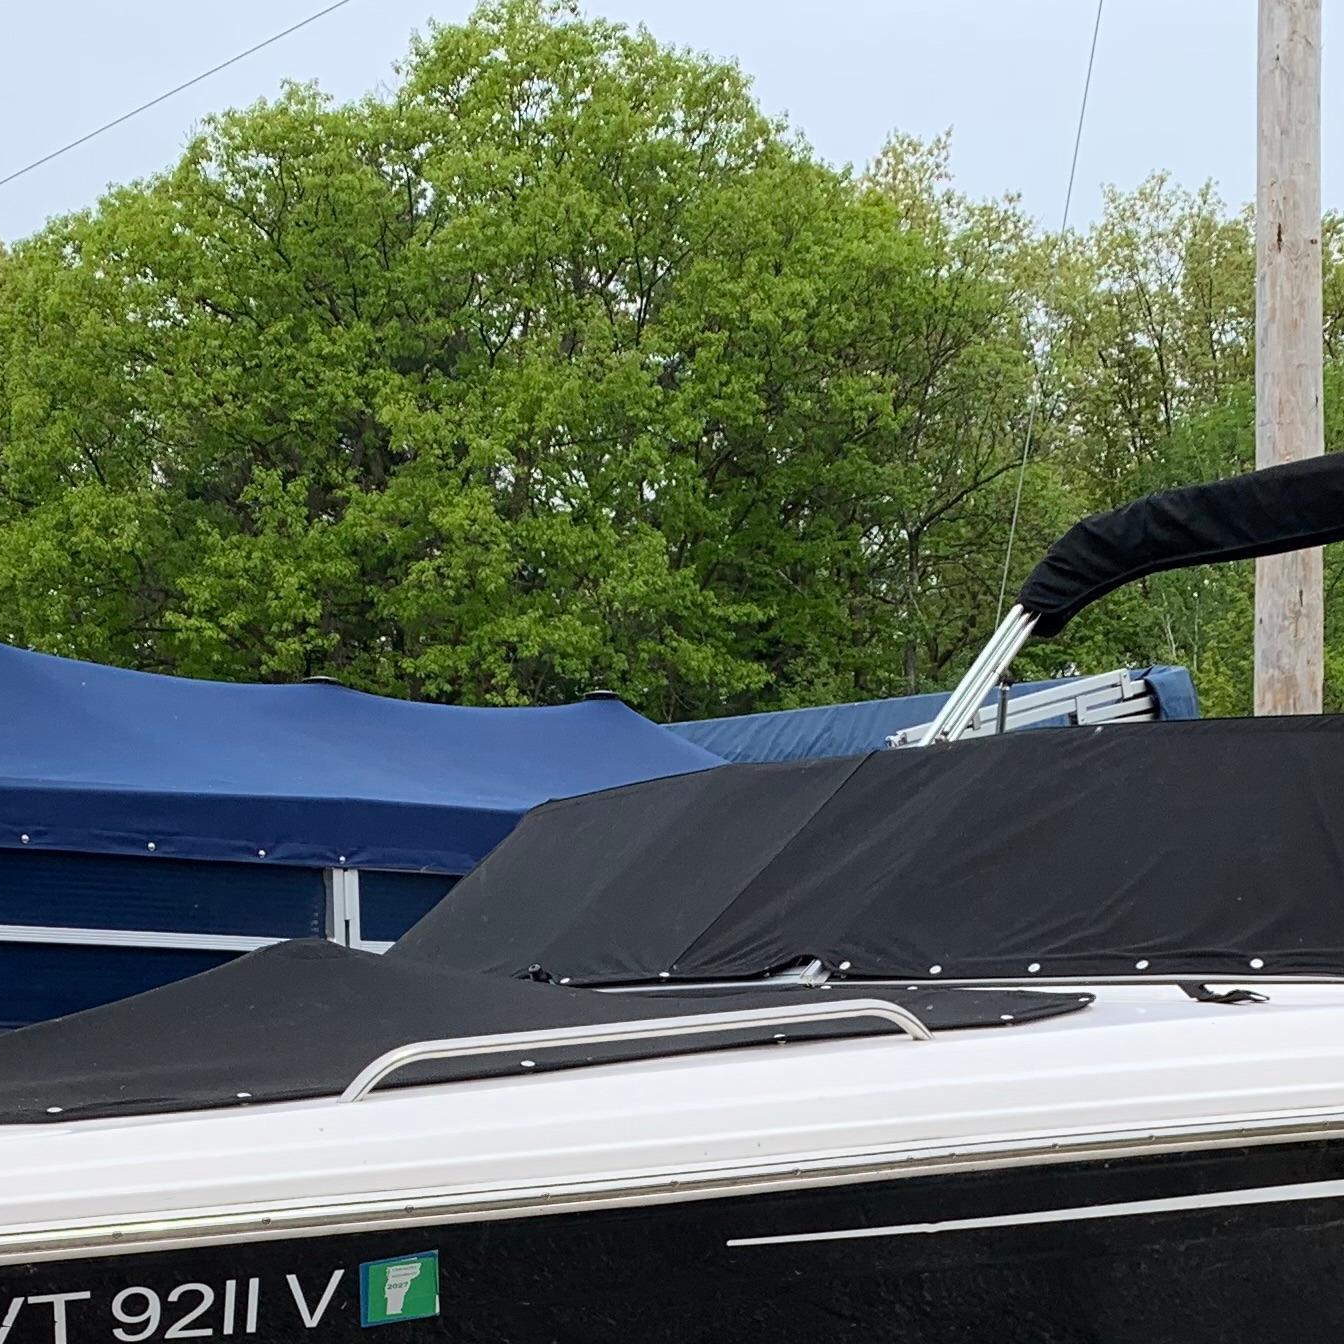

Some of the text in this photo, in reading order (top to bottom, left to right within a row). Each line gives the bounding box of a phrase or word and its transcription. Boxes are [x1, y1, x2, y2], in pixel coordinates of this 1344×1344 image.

[111, 1277, 260, 1342] 9211
[286, 1269, 345, 1328] V
[387, 1281, 409, 1290] 2027
